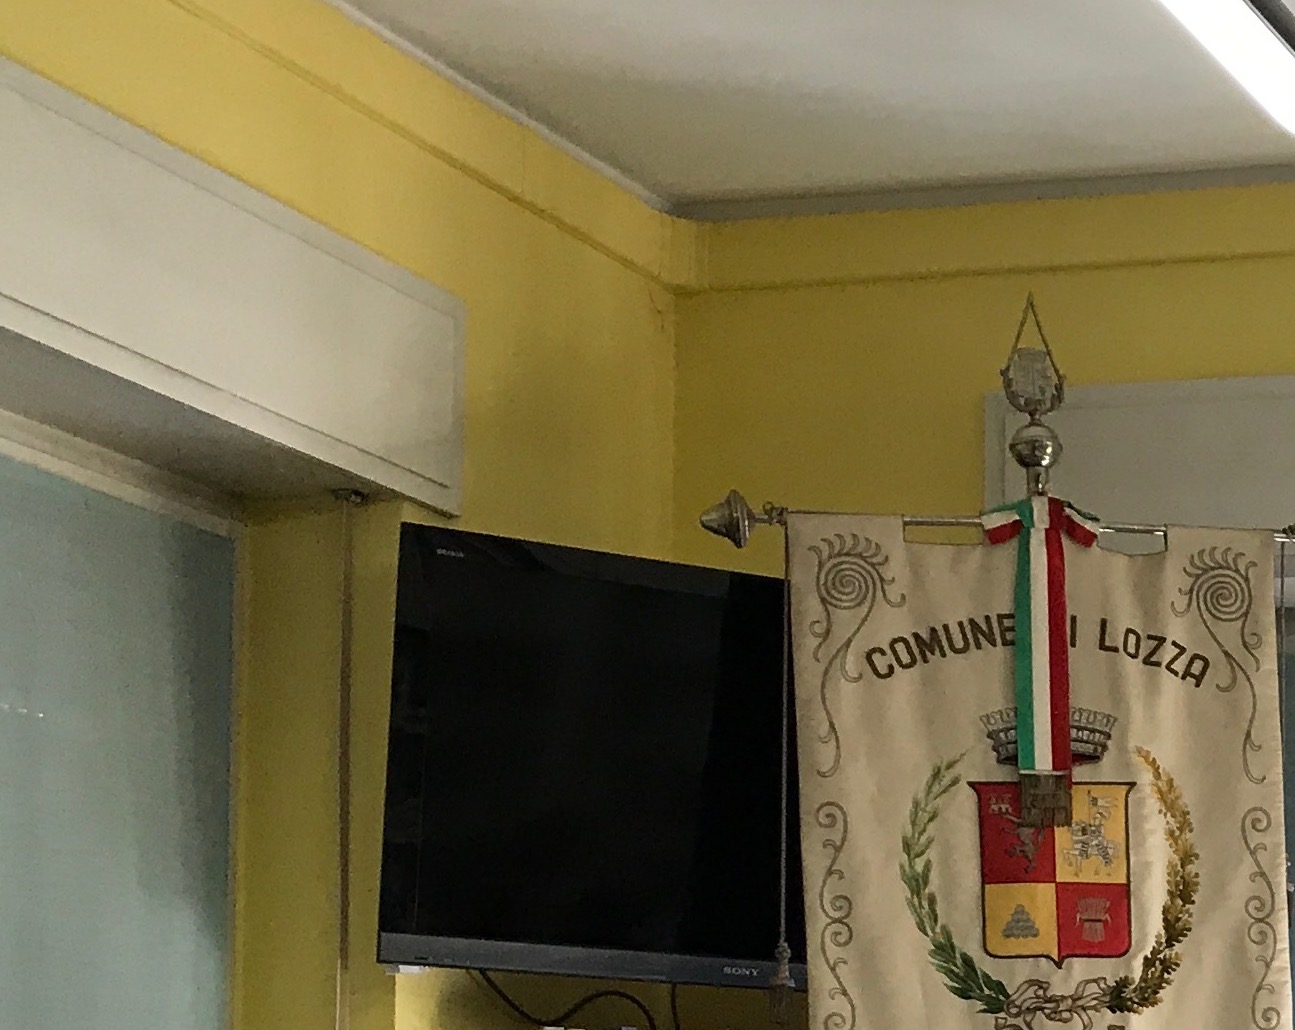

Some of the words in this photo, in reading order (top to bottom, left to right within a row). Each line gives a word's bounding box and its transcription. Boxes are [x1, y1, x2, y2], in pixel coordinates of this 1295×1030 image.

[865, 612, 1015, 680] COMUNE
[1069, 615, 1077, 648] I
[1099, 617, 1211, 688] LOZZA
[723, 965, 760, 976] SONY
